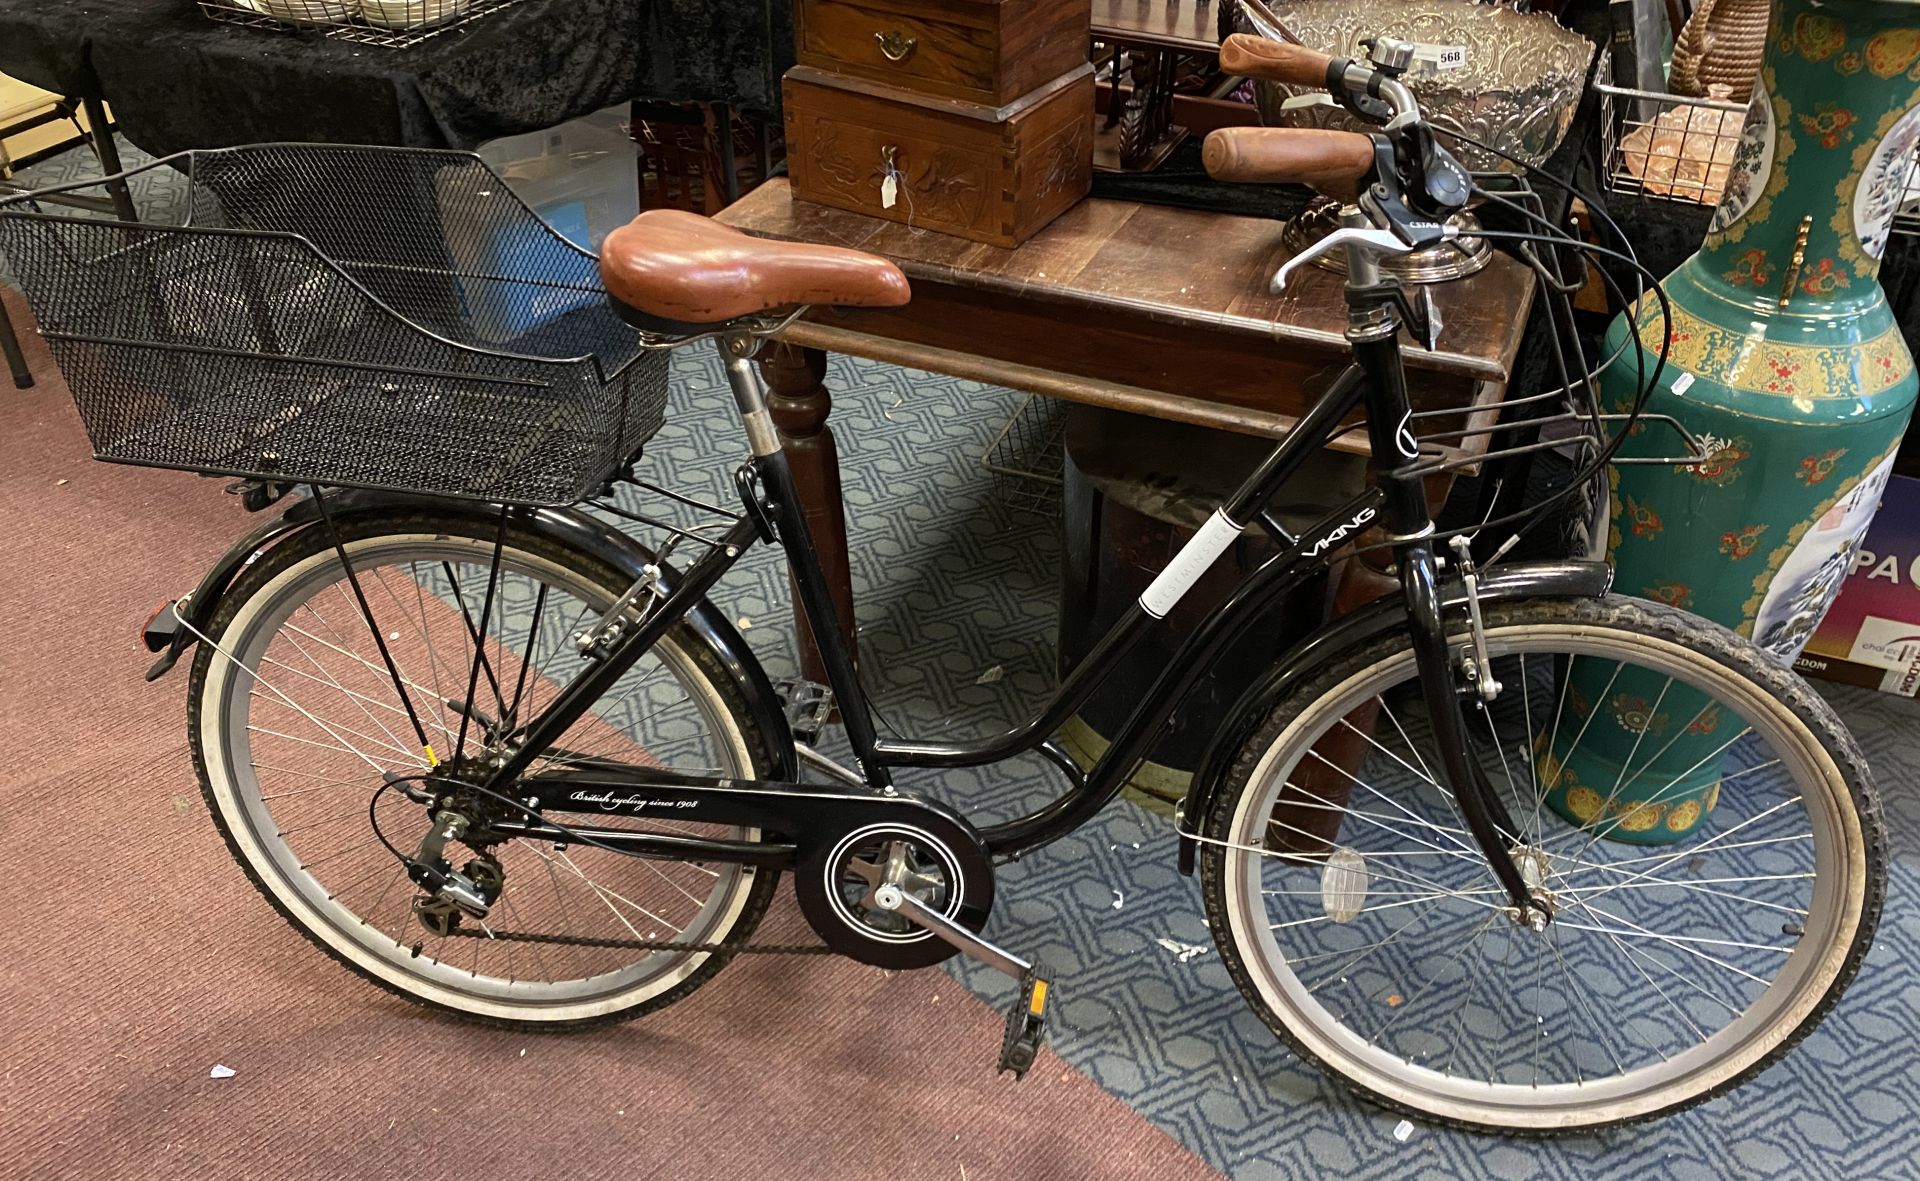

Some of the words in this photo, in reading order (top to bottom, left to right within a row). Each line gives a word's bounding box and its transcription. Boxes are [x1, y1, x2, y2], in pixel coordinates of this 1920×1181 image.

[1440, 51, 1461, 63] 568
[1301, 507, 1376, 556] VIKING
[1152, 525, 1230, 609] WESTMINSTER
[570, 790, 615, 804] British
[603, 793, 648, 812] cycling
[648, 799, 675, 808] since
[675, 800, 699, 809] 1908
